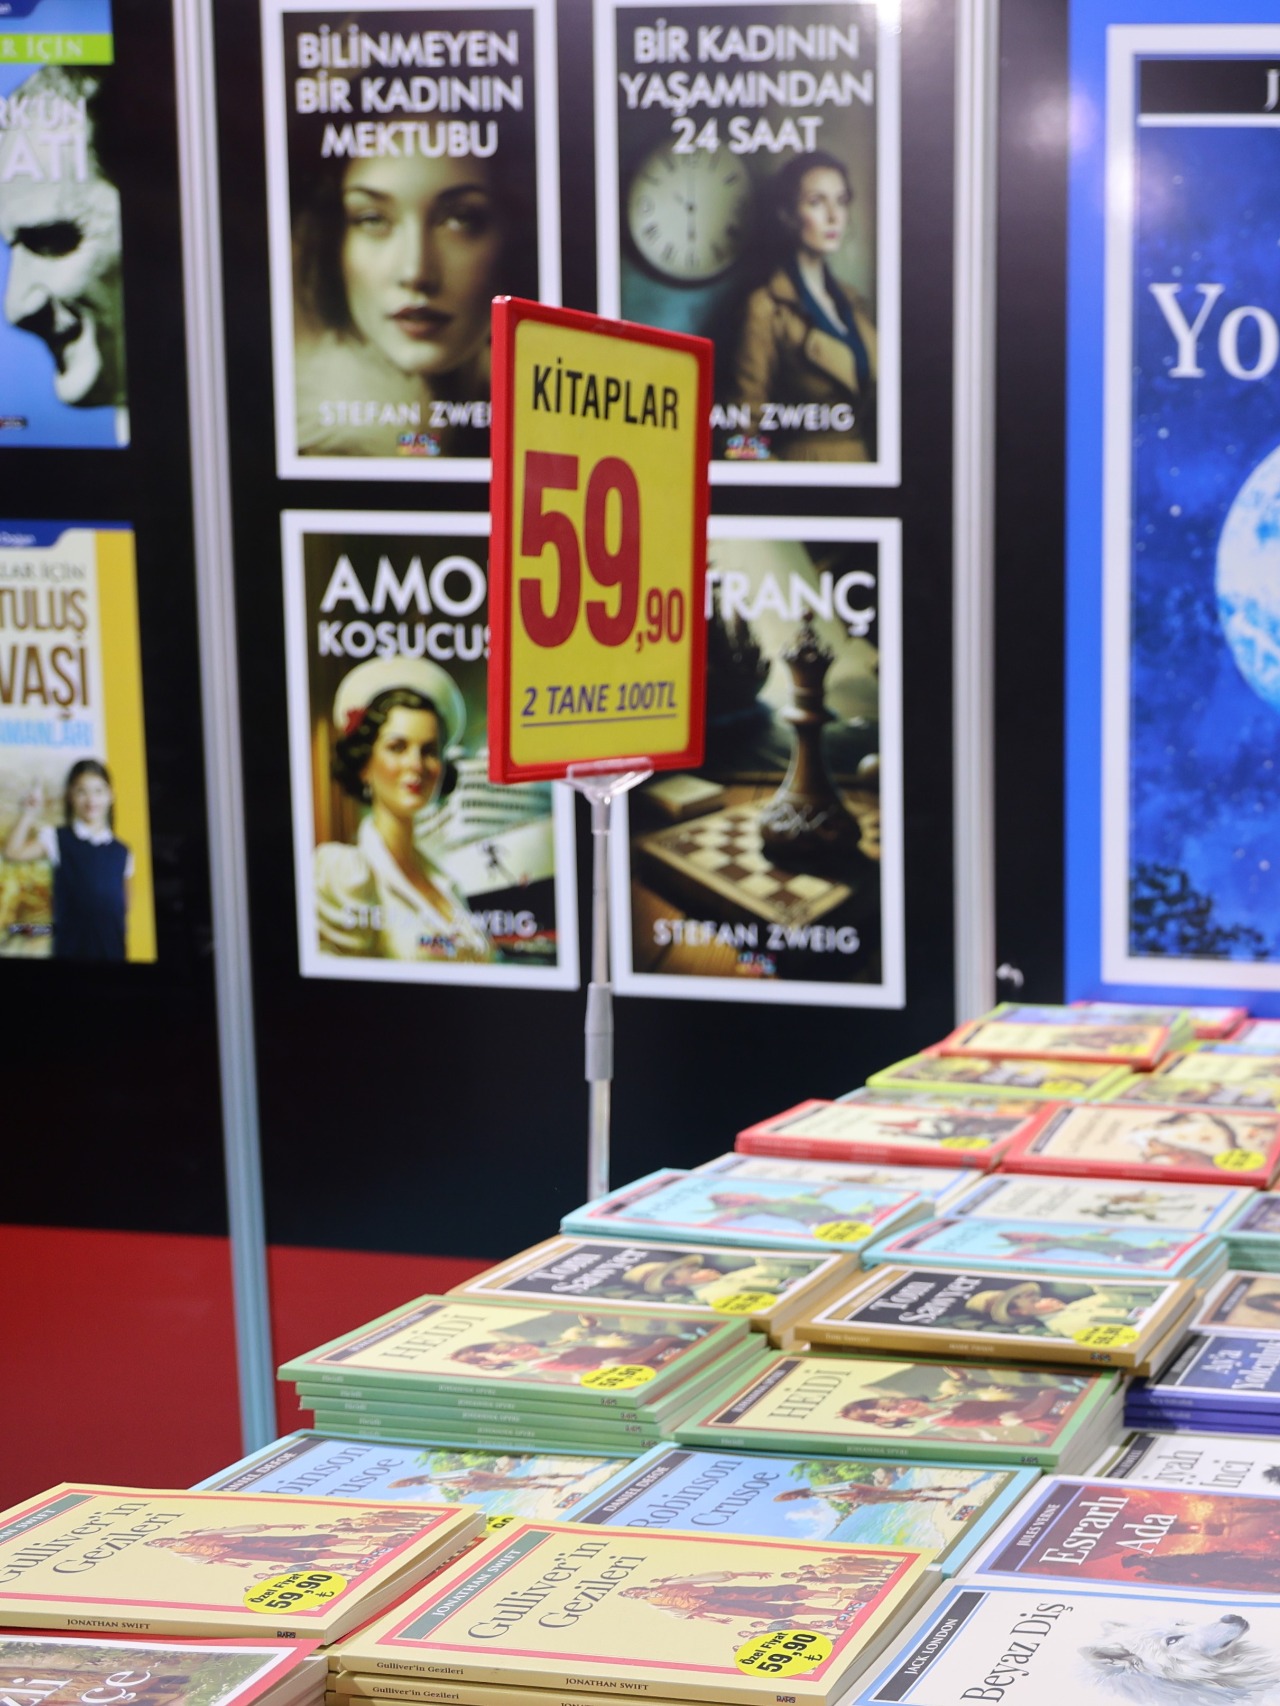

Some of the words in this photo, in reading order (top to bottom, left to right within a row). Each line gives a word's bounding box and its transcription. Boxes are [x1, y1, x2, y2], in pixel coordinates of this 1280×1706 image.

[297, 24, 519, 69] BİLİNMEYEN
[634, 18, 691, 63] BİR
[698, 24, 859, 62] KADININ
[295, 70, 352, 113] BİR
[361, 75, 523, 113] KADININ
[619, 70, 874, 117] YAŞAMINDAN
[321, 120, 498, 158] MEKTUBU
[671, 117, 720, 154] 24
[728, 116, 823, 154] SAAT
[0, 132, 88, 183] ATI
[319, 401, 421, 428] STEFAN
[532, 358, 679, 430] KİTAPLAR
[759, 402, 855, 432] ZWEIG
[519, 449, 685, 653] 59,90
[320, 554, 488, 618] AMO
[317, 620, 491, 664] KOŞUCU
[521, 687, 537, 717] 2
[546, 683, 609, 714] TANE
[616, 681, 677, 711] 100TL
[653, 918, 758, 947] STEFAN
[766, 923, 860, 954] ZWEIG
[869, 1280, 936, 1312] Tom
[379, 1313, 487, 1360] HEİDİ
[767, 1368, 852, 1420] HEİDİ
[261, 1446, 374, 1494] binson
[326, 1457, 405, 1497] rusoe
[626, 1460, 743, 1528] Robinson
[691, 1471, 780, 1526] Crusoe
[15, 1509, 57, 1530] SWIFT
[1016, 1526, 1042, 1547] JULES
[1036, 1504, 1061, 1528] VERNE
[1039, 1496, 1131, 1566] Esrarlı
[1116, 1513, 1178, 1555] Ada
[53, 1512, 185, 1574] Gezileri
[248, 1588, 279, 1604] Özel
[276, 1573, 305, 1590] Fiyat
[265, 1574, 333, 1609] 59,90
[431, 1573, 492, 1617] JONATHAN
[487, 1549, 522, 1573] SWIFT
[467, 1541, 611, 1639] Gulliver'in
[538, 1555, 648, 1629] Gezileri
[67, 1619, 119, 1628] JONATHAN
[121, 1622, 151, 1630] SWIFT
[904, 1655, 930, 1675] JACK
[922, 1618, 958, 1655] LONDON
[739, 1650, 768, 1666] Özel
[760, 1632, 789, 1649] Fiyat
[756, 1633, 817, 1673] 59,90
[959, 1641, 1042, 1703] Beyaz
[1010, 1603, 1074, 1637] Diş
[372, 1686, 421, 1697] Gulliver'in
[423, 1690, 460, 1700] Gezileri
[376, 1661, 425, 1673] Gulliver'in
[427, 1666, 464, 1675] Gezileri
[565, 1677, 617, 1688] JONATHAN
[619, 1682, 649, 1691] SWIFT
